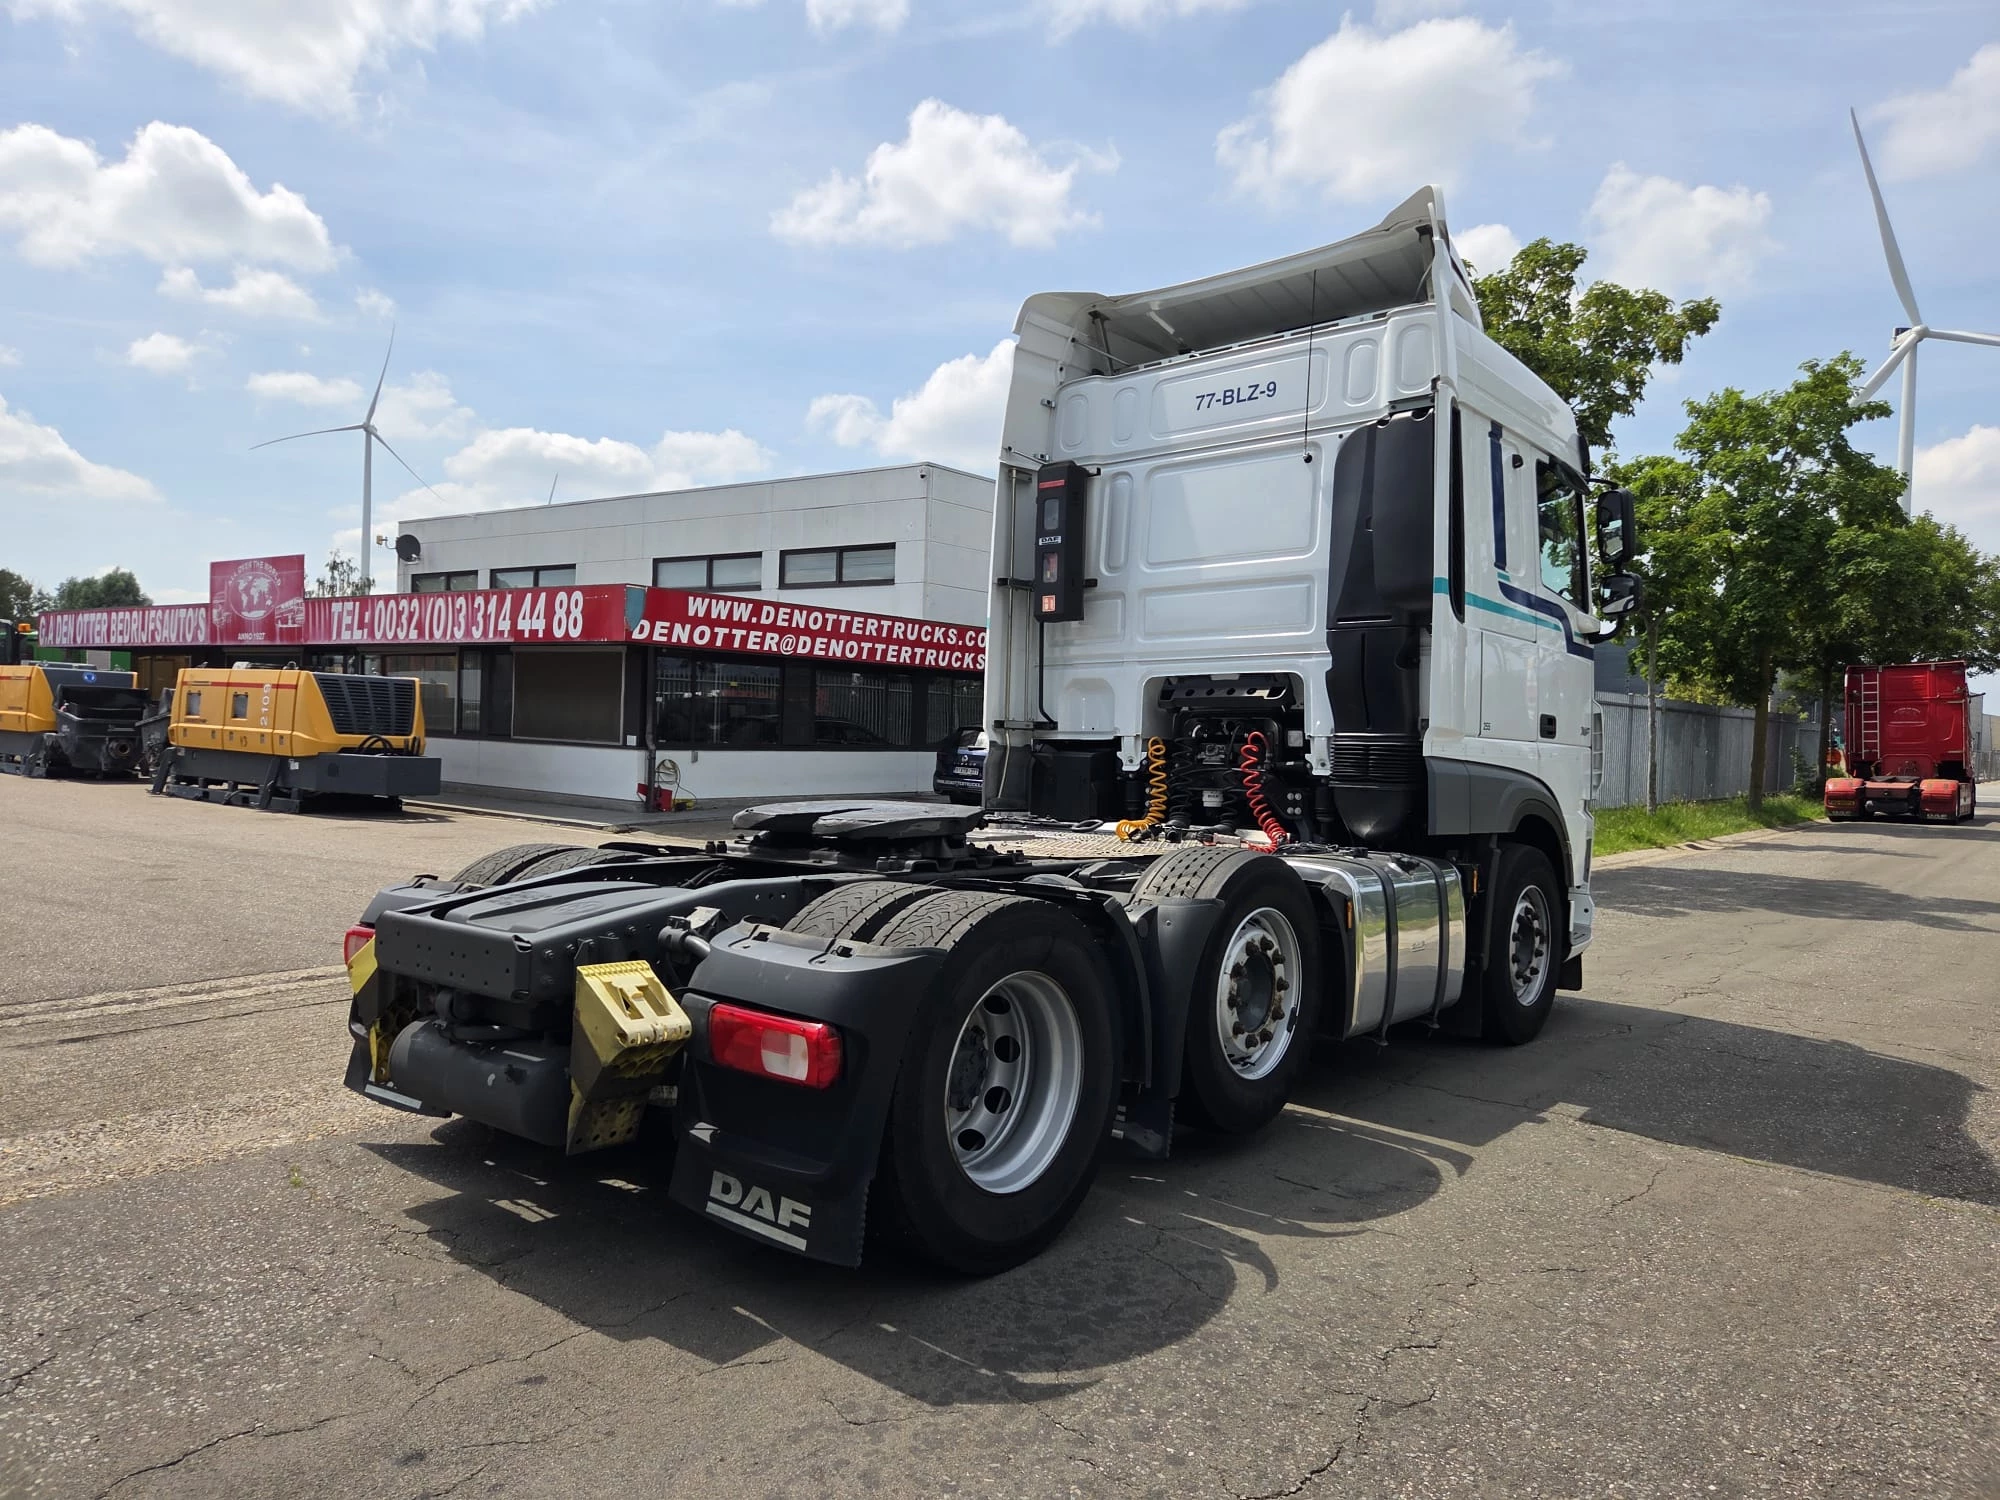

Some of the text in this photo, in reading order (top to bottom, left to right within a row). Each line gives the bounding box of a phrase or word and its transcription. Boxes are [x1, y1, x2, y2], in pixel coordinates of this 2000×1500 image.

[1196, 381, 1277, 411] 77-BLZ-9
[56, 613, 74, 644] DEN
[76, 611, 108, 644] OTTER
[110, 607, 206, 644] BEDRIJFSAUTO'S
[238, 632, 253, 640] ANNO
[331, 590, 583, 640] TEL: 0032 (0)3 314 44 88
[632, 619, 985, 670] DENOTTER@DENOTTERTRUCKS
[710, 1170, 812, 1228] DAF
